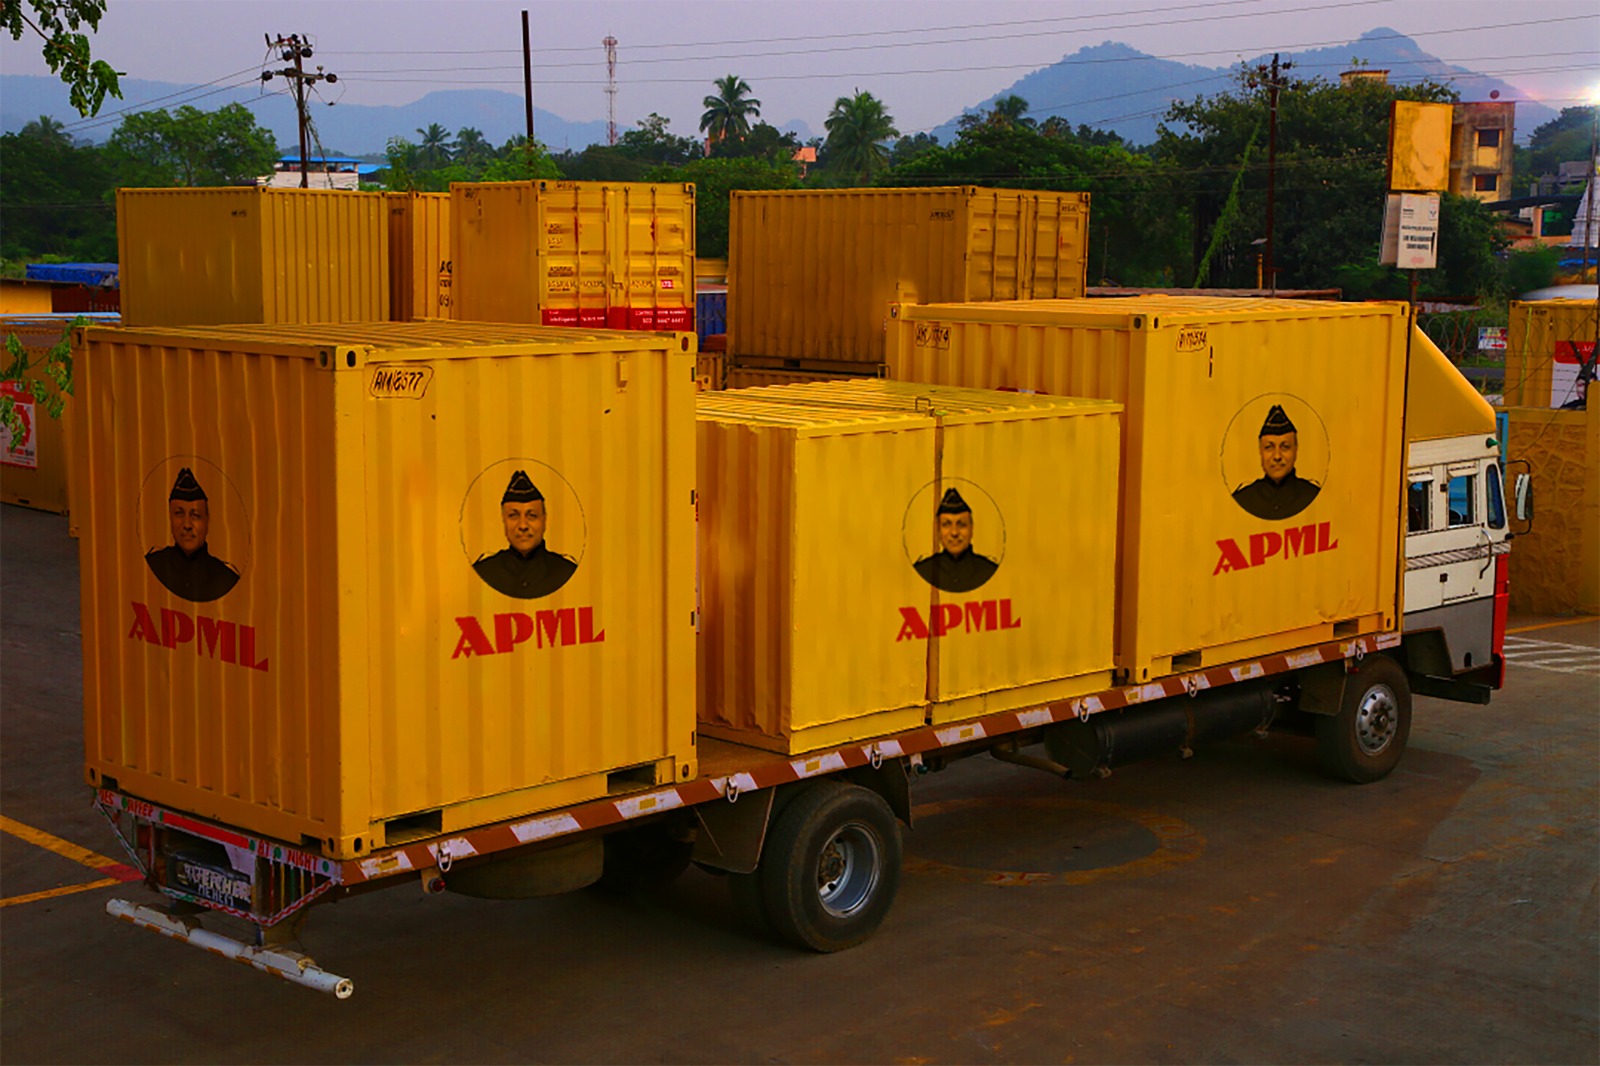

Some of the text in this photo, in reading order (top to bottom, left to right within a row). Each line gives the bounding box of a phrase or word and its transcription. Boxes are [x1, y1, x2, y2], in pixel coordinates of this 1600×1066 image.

[1213, 521, 1338, 576] APML
[128, 601, 268, 672] APML
[451, 606, 605, 660] APML
[896, 598, 1021, 642] APML
